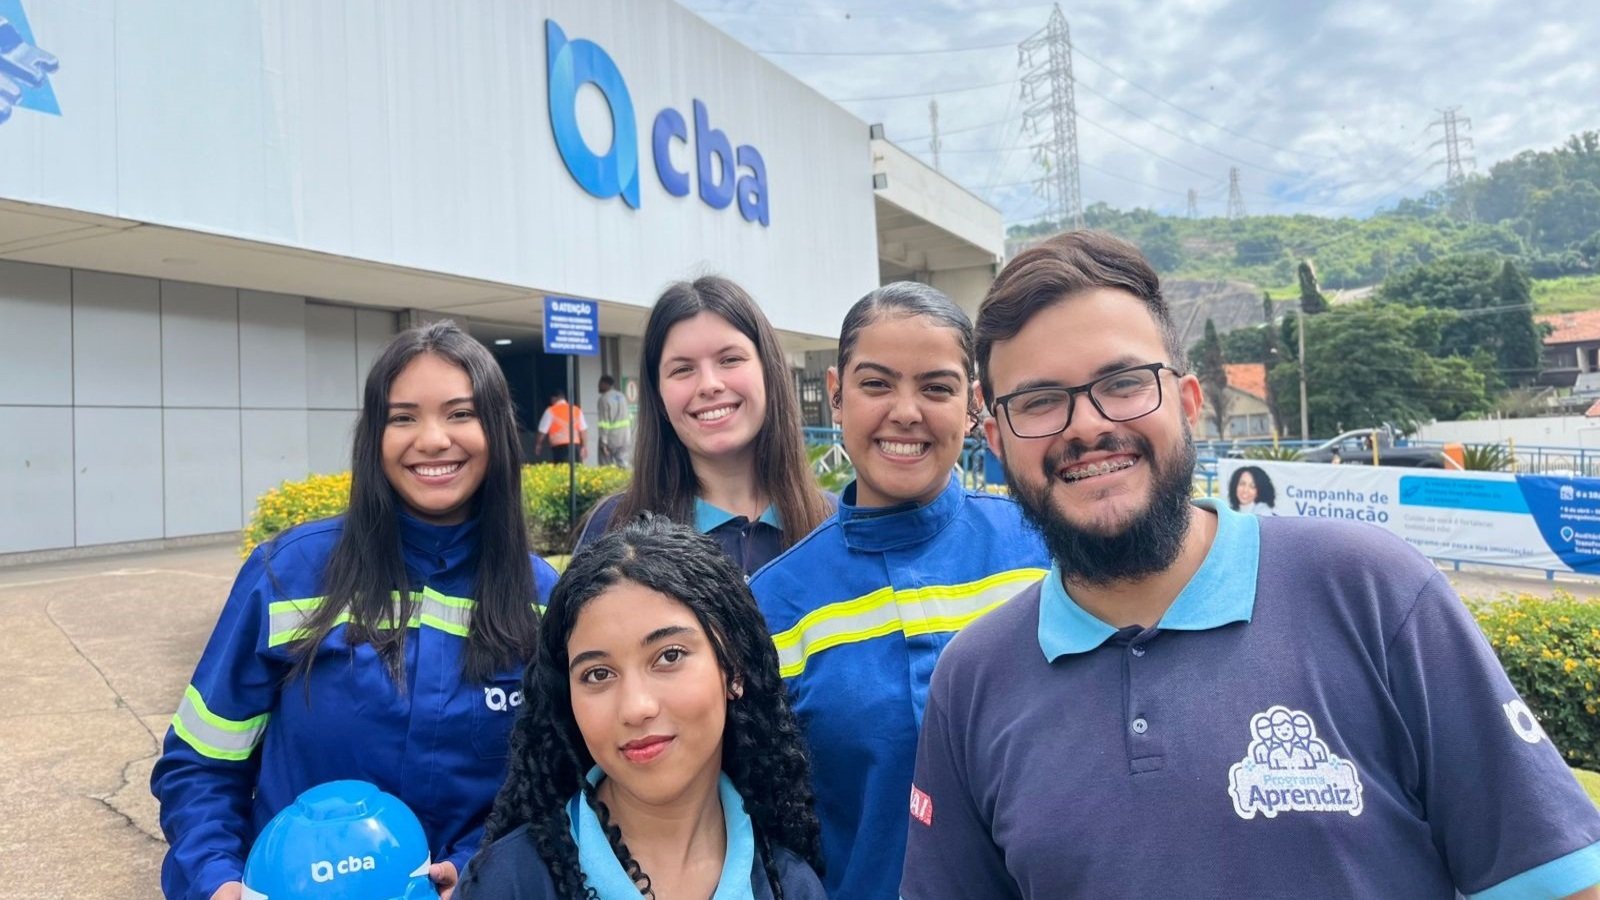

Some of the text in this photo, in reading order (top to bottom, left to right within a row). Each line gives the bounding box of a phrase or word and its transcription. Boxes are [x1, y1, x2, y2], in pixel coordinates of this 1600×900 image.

[652, 98, 770, 228] cba
[1286, 485, 1389, 504] Campanha de
[1263, 774, 1326, 787] Programa
[1248, 783, 1353, 811] Aprendiz
[337, 855, 376, 875] cba
